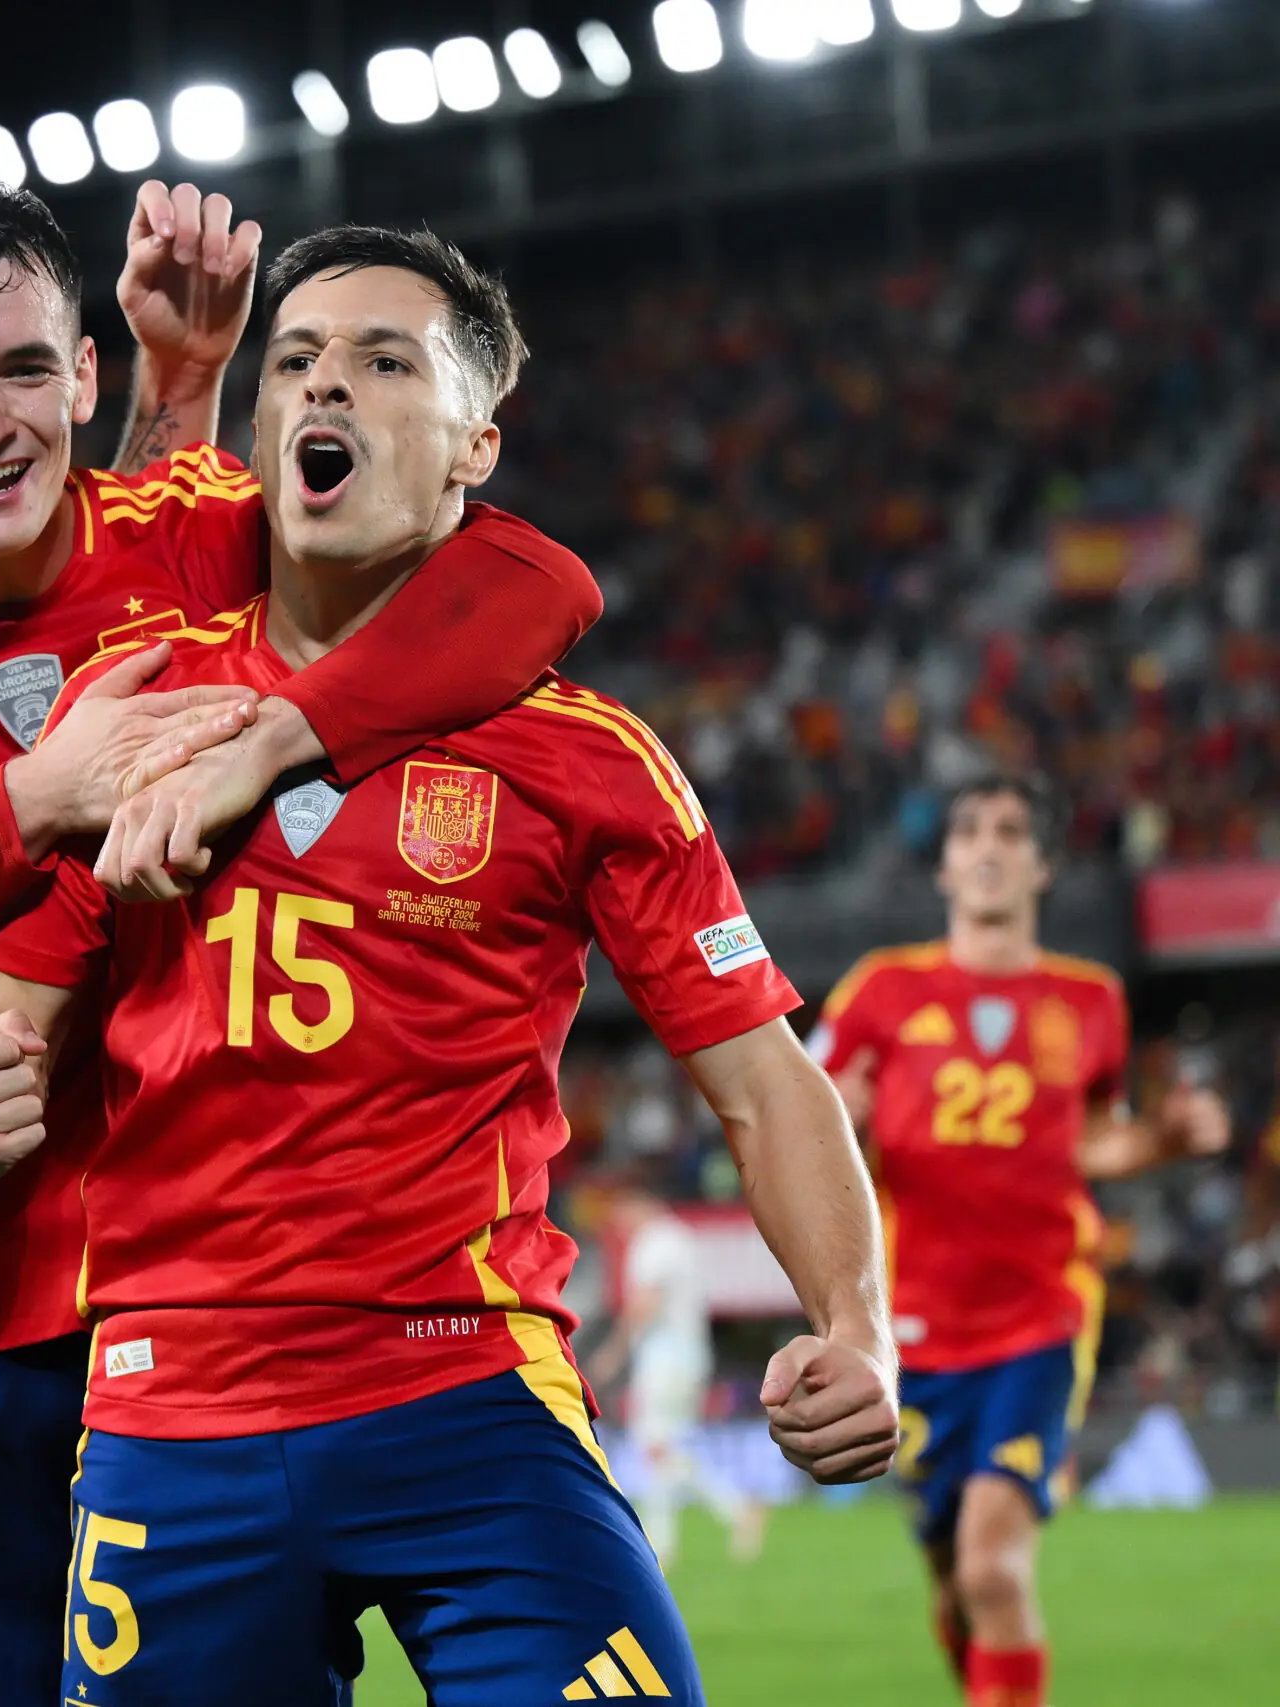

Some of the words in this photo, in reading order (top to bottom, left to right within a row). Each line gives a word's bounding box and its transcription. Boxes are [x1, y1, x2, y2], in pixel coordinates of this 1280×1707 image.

[6, 662, 32, 676] UEFA
[285, 816, 320, 831] 2024
[386, 889, 412, 901] SPAIN
[421, 893, 481, 911] SWITZERLAND
[390, 900, 400, 910] 18
[403, 901, 451, 918] NOVEMBER
[453, 909, 475, 921] 2024
[377, 909, 406, 922] SANTA
[408, 913, 432, 926] CRUZ
[433, 917, 445, 928] DE
[448, 918, 482, 932] TENERIFE
[699, 927, 725, 944] UEFA
[206, 887, 354, 1053] 15
[931, 1057, 1035, 1148] 22
[406, 1316, 480, 1339] HEAT.RDY
